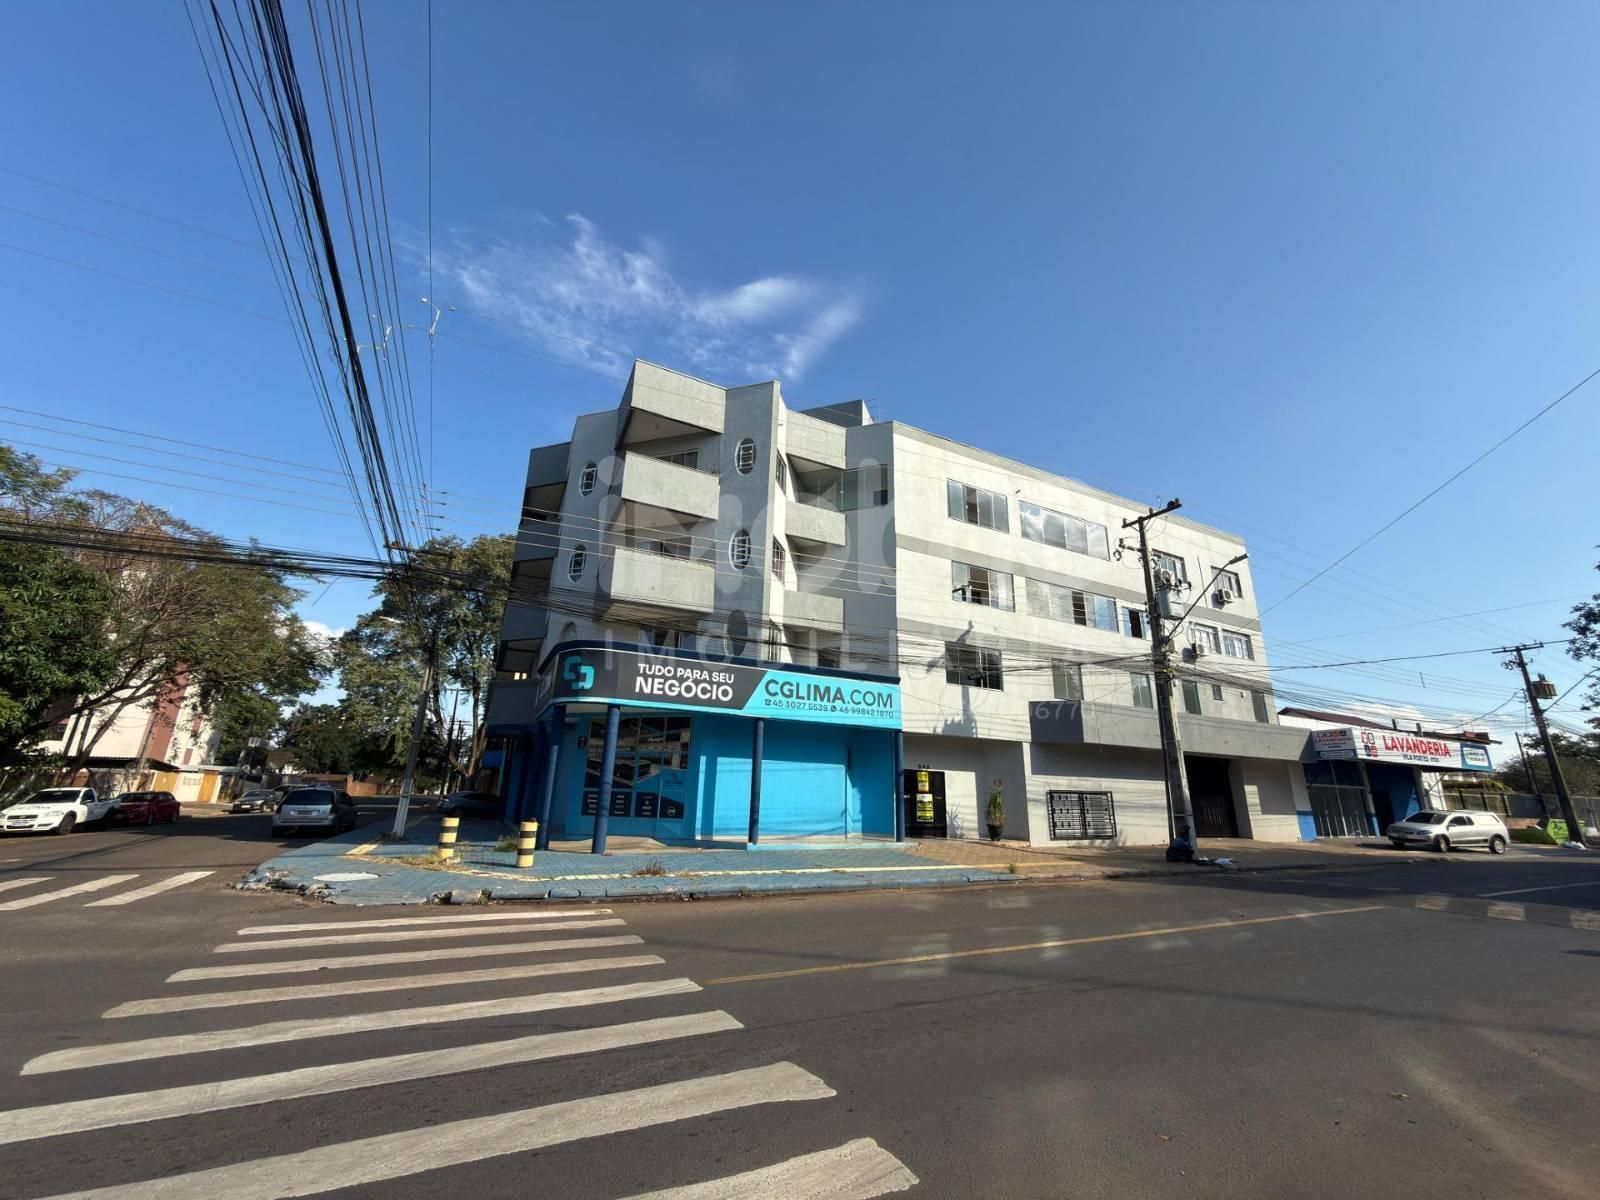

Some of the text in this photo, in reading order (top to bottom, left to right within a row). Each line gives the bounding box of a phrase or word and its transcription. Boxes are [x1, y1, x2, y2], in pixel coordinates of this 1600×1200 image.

[638, 663, 735, 684] TUDO PARA SEU
[635, 676, 733, 702] NEGÓCIO
[764, 678, 893, 709] CGLIMA.COM
[1382, 735, 1452, 757] LAVANDERIA
